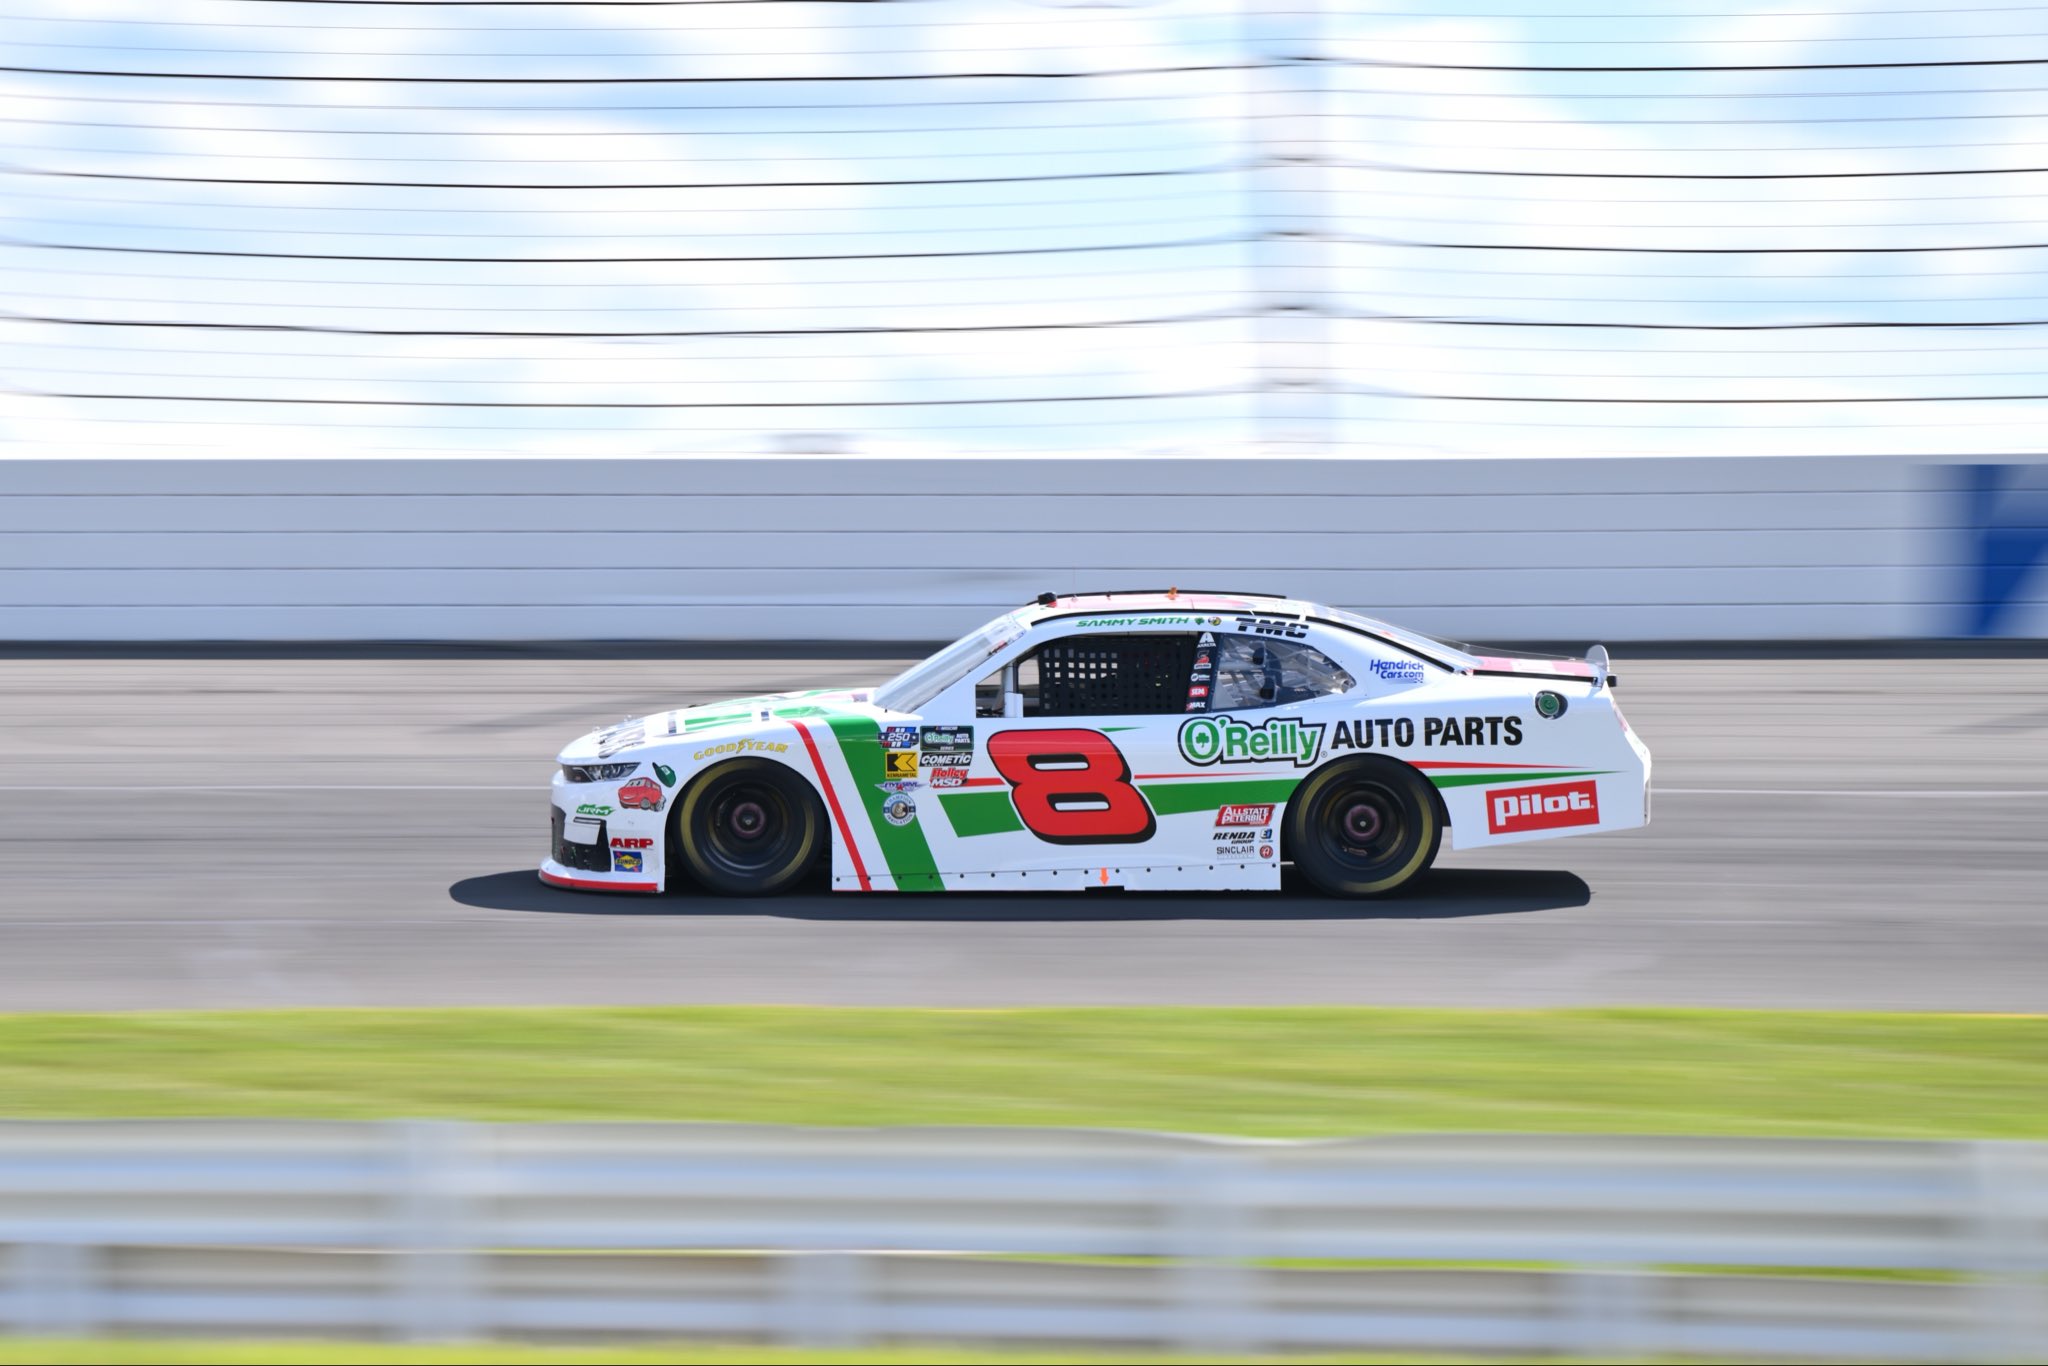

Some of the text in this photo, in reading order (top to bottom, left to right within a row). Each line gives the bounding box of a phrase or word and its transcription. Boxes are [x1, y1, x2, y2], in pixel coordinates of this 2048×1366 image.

[1076, 617, 1190, 627] SAMMY SMITH
[1235, 617, 1309, 638] TMC
[1370, 659, 1424, 674] Hendrick
[1380, 670, 1424, 679] Cars.com
[887, 733, 910, 741] 250
[1184, 716, 1523, 762] O'Reilly AUTO PARTS
[921, 753, 972, 764] COMETIC
[931, 767, 968, 779] Holley
[931, 778, 963, 787] MSD
[987, 729, 1156, 845] 8
[1224, 806, 1269, 815] ALLSTATE
[1222, 813, 1269, 824] PETERBILT
[1213, 832, 1255, 840] RENDA
[610, 837, 654, 848] ARP
[1216, 846, 1254, 854] SINCLAIR
